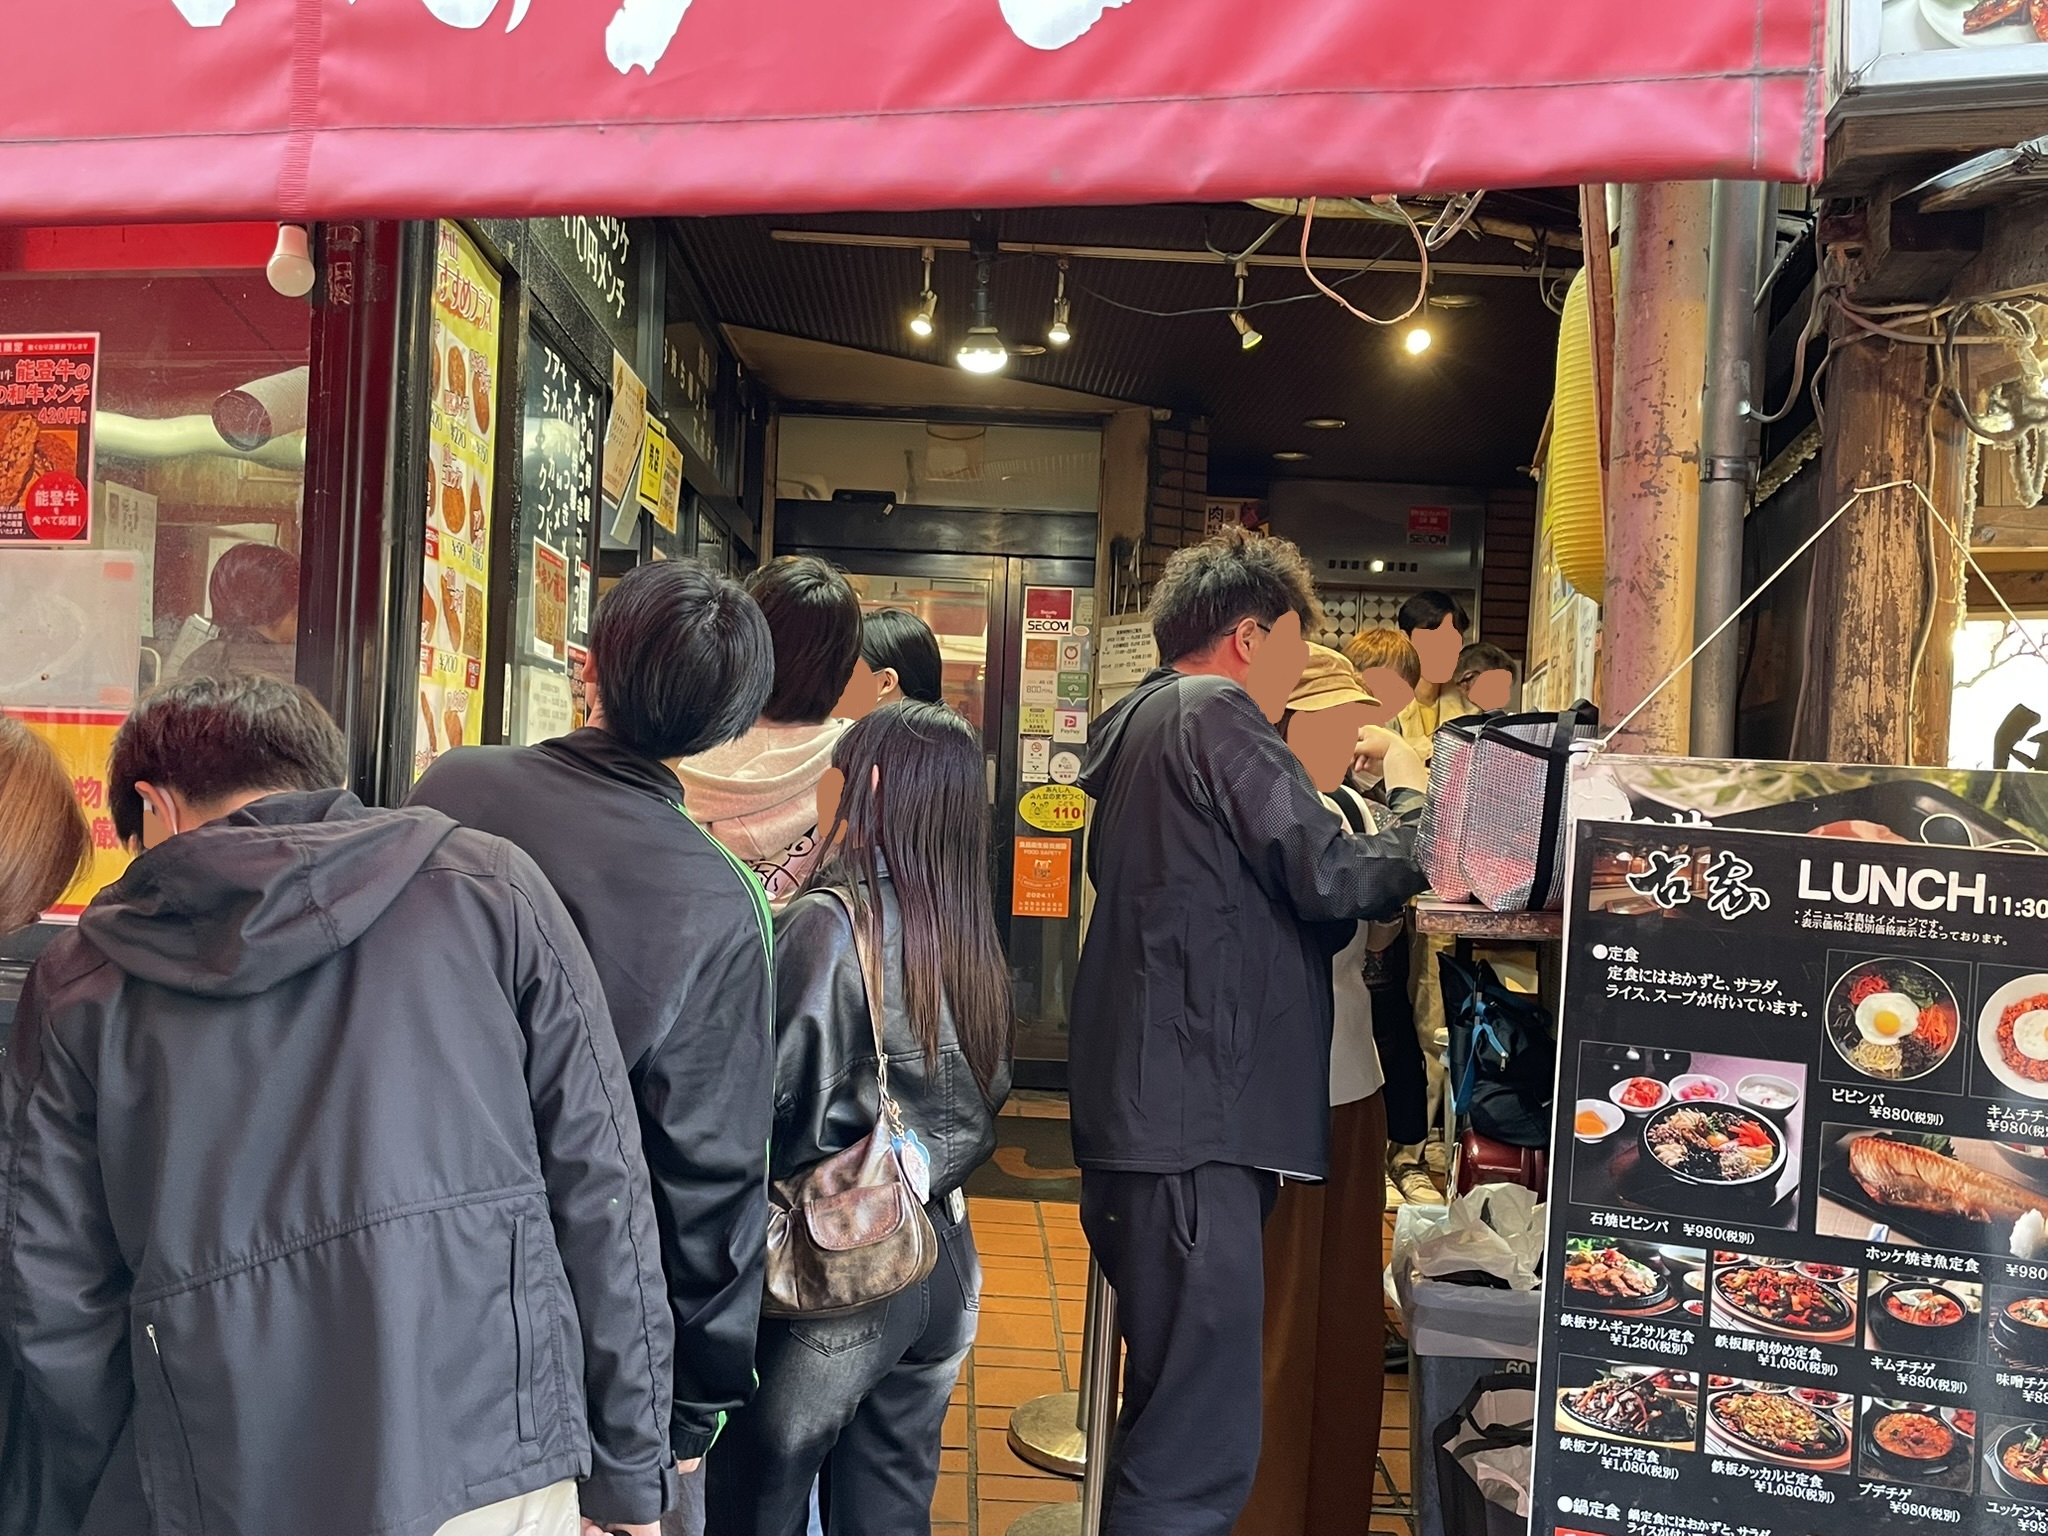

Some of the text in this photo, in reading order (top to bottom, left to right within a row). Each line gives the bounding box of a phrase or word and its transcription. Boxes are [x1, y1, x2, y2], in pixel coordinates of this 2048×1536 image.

[0, 342, 23, 353] 限定
[15, 358, 91, 383] 能登牛の
[38, 406, 81, 425] 420円
[34, 490, 80, 507] 能登牛
[572, 411, 587, 634] やみつきコロッケ
[1208, 506, 1224, 522] 肉
[1409, 533, 1447, 544] SECOM
[1028, 620, 1069, 631] SECOM
[74, 776, 102, 809] 物
[1045, 786, 1071, 794] あんしん
[1053, 806, 1085, 820] 110
[1798, 858, 1987, 914] LUNCH
[1607, 965, 1783, 996] 定食にはおかずと、サラダ、
[1605, 984, 1809, 1018] ライス、スープが付いています。
[1869, 1105, 1944, 1126] ¥880(税別)
[1987, 1104, 2048, 1121] キムチチ
[1682, 1223, 1755, 1245] ¥980(税別)
[1865, 1246, 1980, 1274] ホッケ焼き魚定食
[2005, 1263, 2048, 1281] ¥980
[1610, 1333, 1688, 1356] ¥1,280(税別)
[1714, 1334, 1822, 1362] 鉄板豚肉炒め定食
[1758, 1354, 1838, 1376] ¥1,080(税別)
[1870, 1356, 1936, 1375] キムチチゲ
[1896, 1373, 1968, 1394] ¥880(税別)
[1601, 1457, 1679, 1480] ¥1,080(税別)
[1711, 1459, 1823, 1490] 鉄板タッカルビ定食
[1754, 1479, 1835, 1504] ¥1,080(税別)
[1573, 1497, 1620, 1522] 鍋定食
[1889, 1501, 1961, 1523] ¥980(税別)
[2018, 1518, 2048, 1534] ¥98
